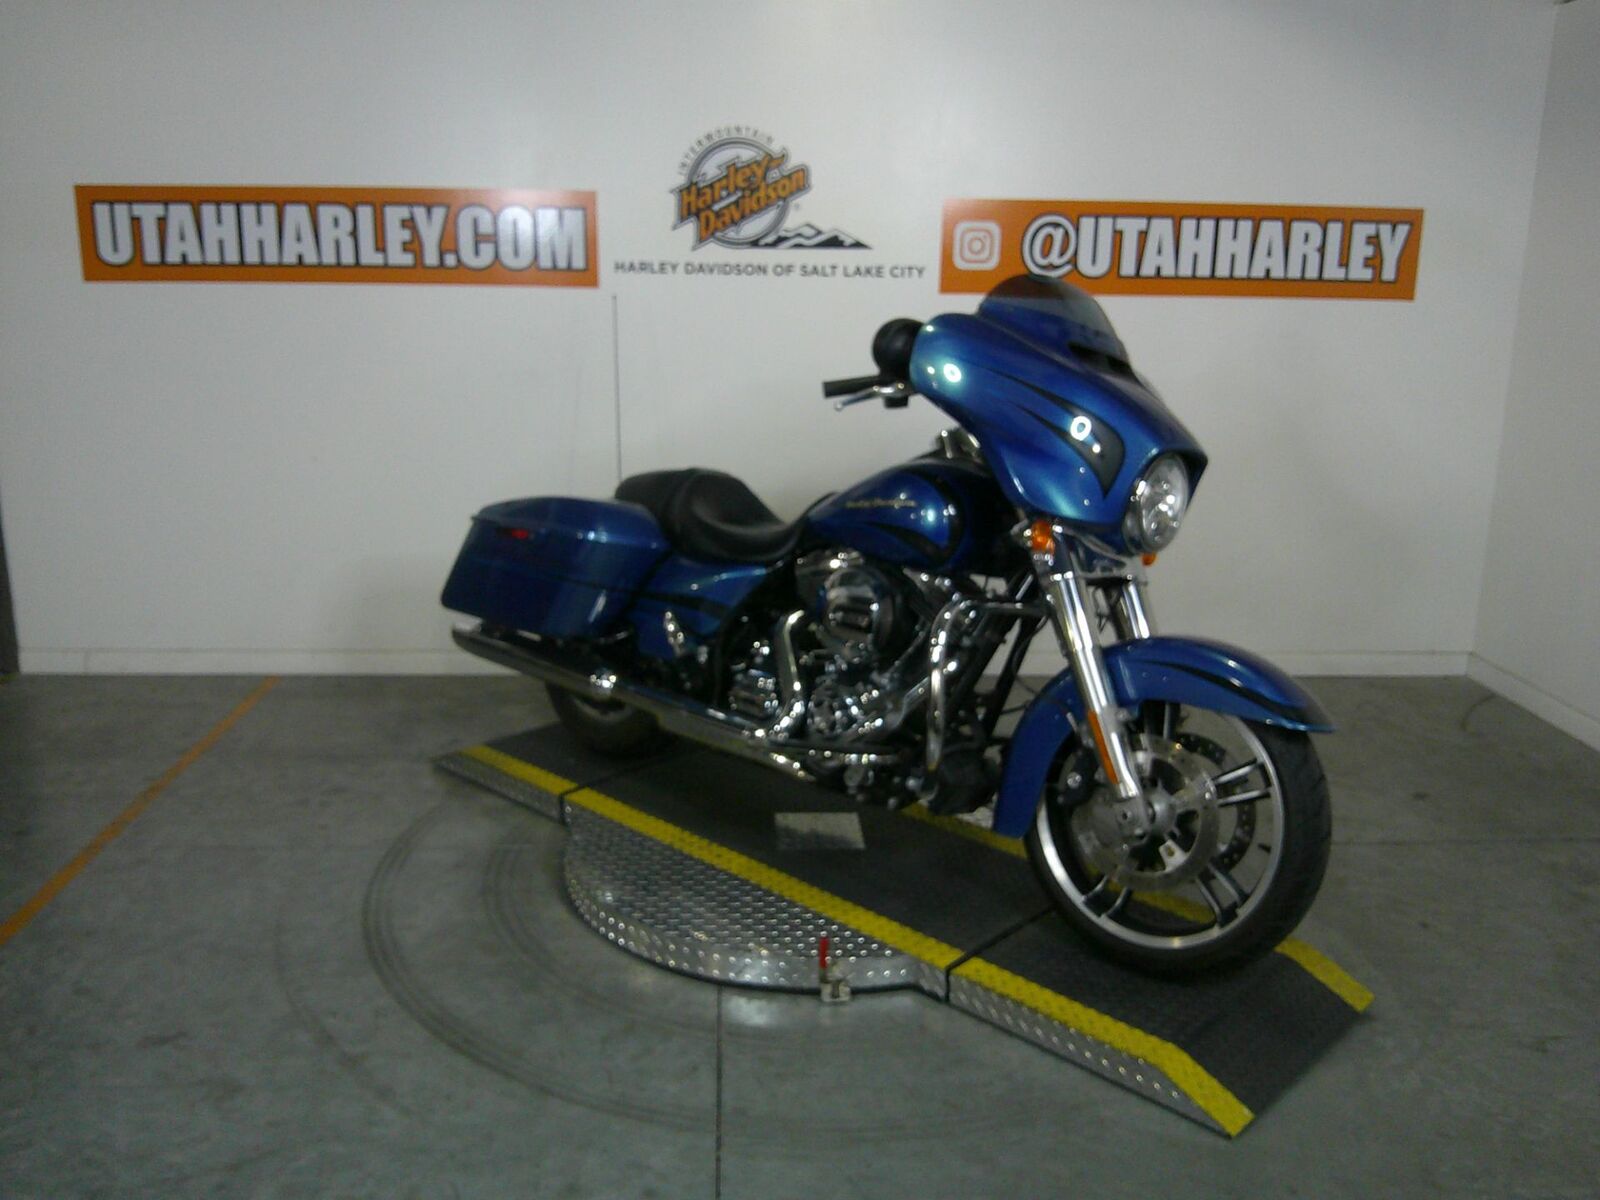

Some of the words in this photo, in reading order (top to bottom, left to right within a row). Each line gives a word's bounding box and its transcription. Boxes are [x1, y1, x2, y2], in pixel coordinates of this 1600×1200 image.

[679, 152, 786, 221] Harley
[698, 167, 807, 242] Davidson
[91, 201, 588, 272] UTAHHARLEY.COM
[614, 261, 680, 275] HARLEY
[684, 262, 768, 277] DAVIDSON
[773, 264, 794, 277] OF
[800, 264, 838, 278] SALT
[843, 265, 884, 279] LAKE
[889, 265, 926, 280] CITY
[1020, 213, 1411, 284] @UTAHHARLEY
